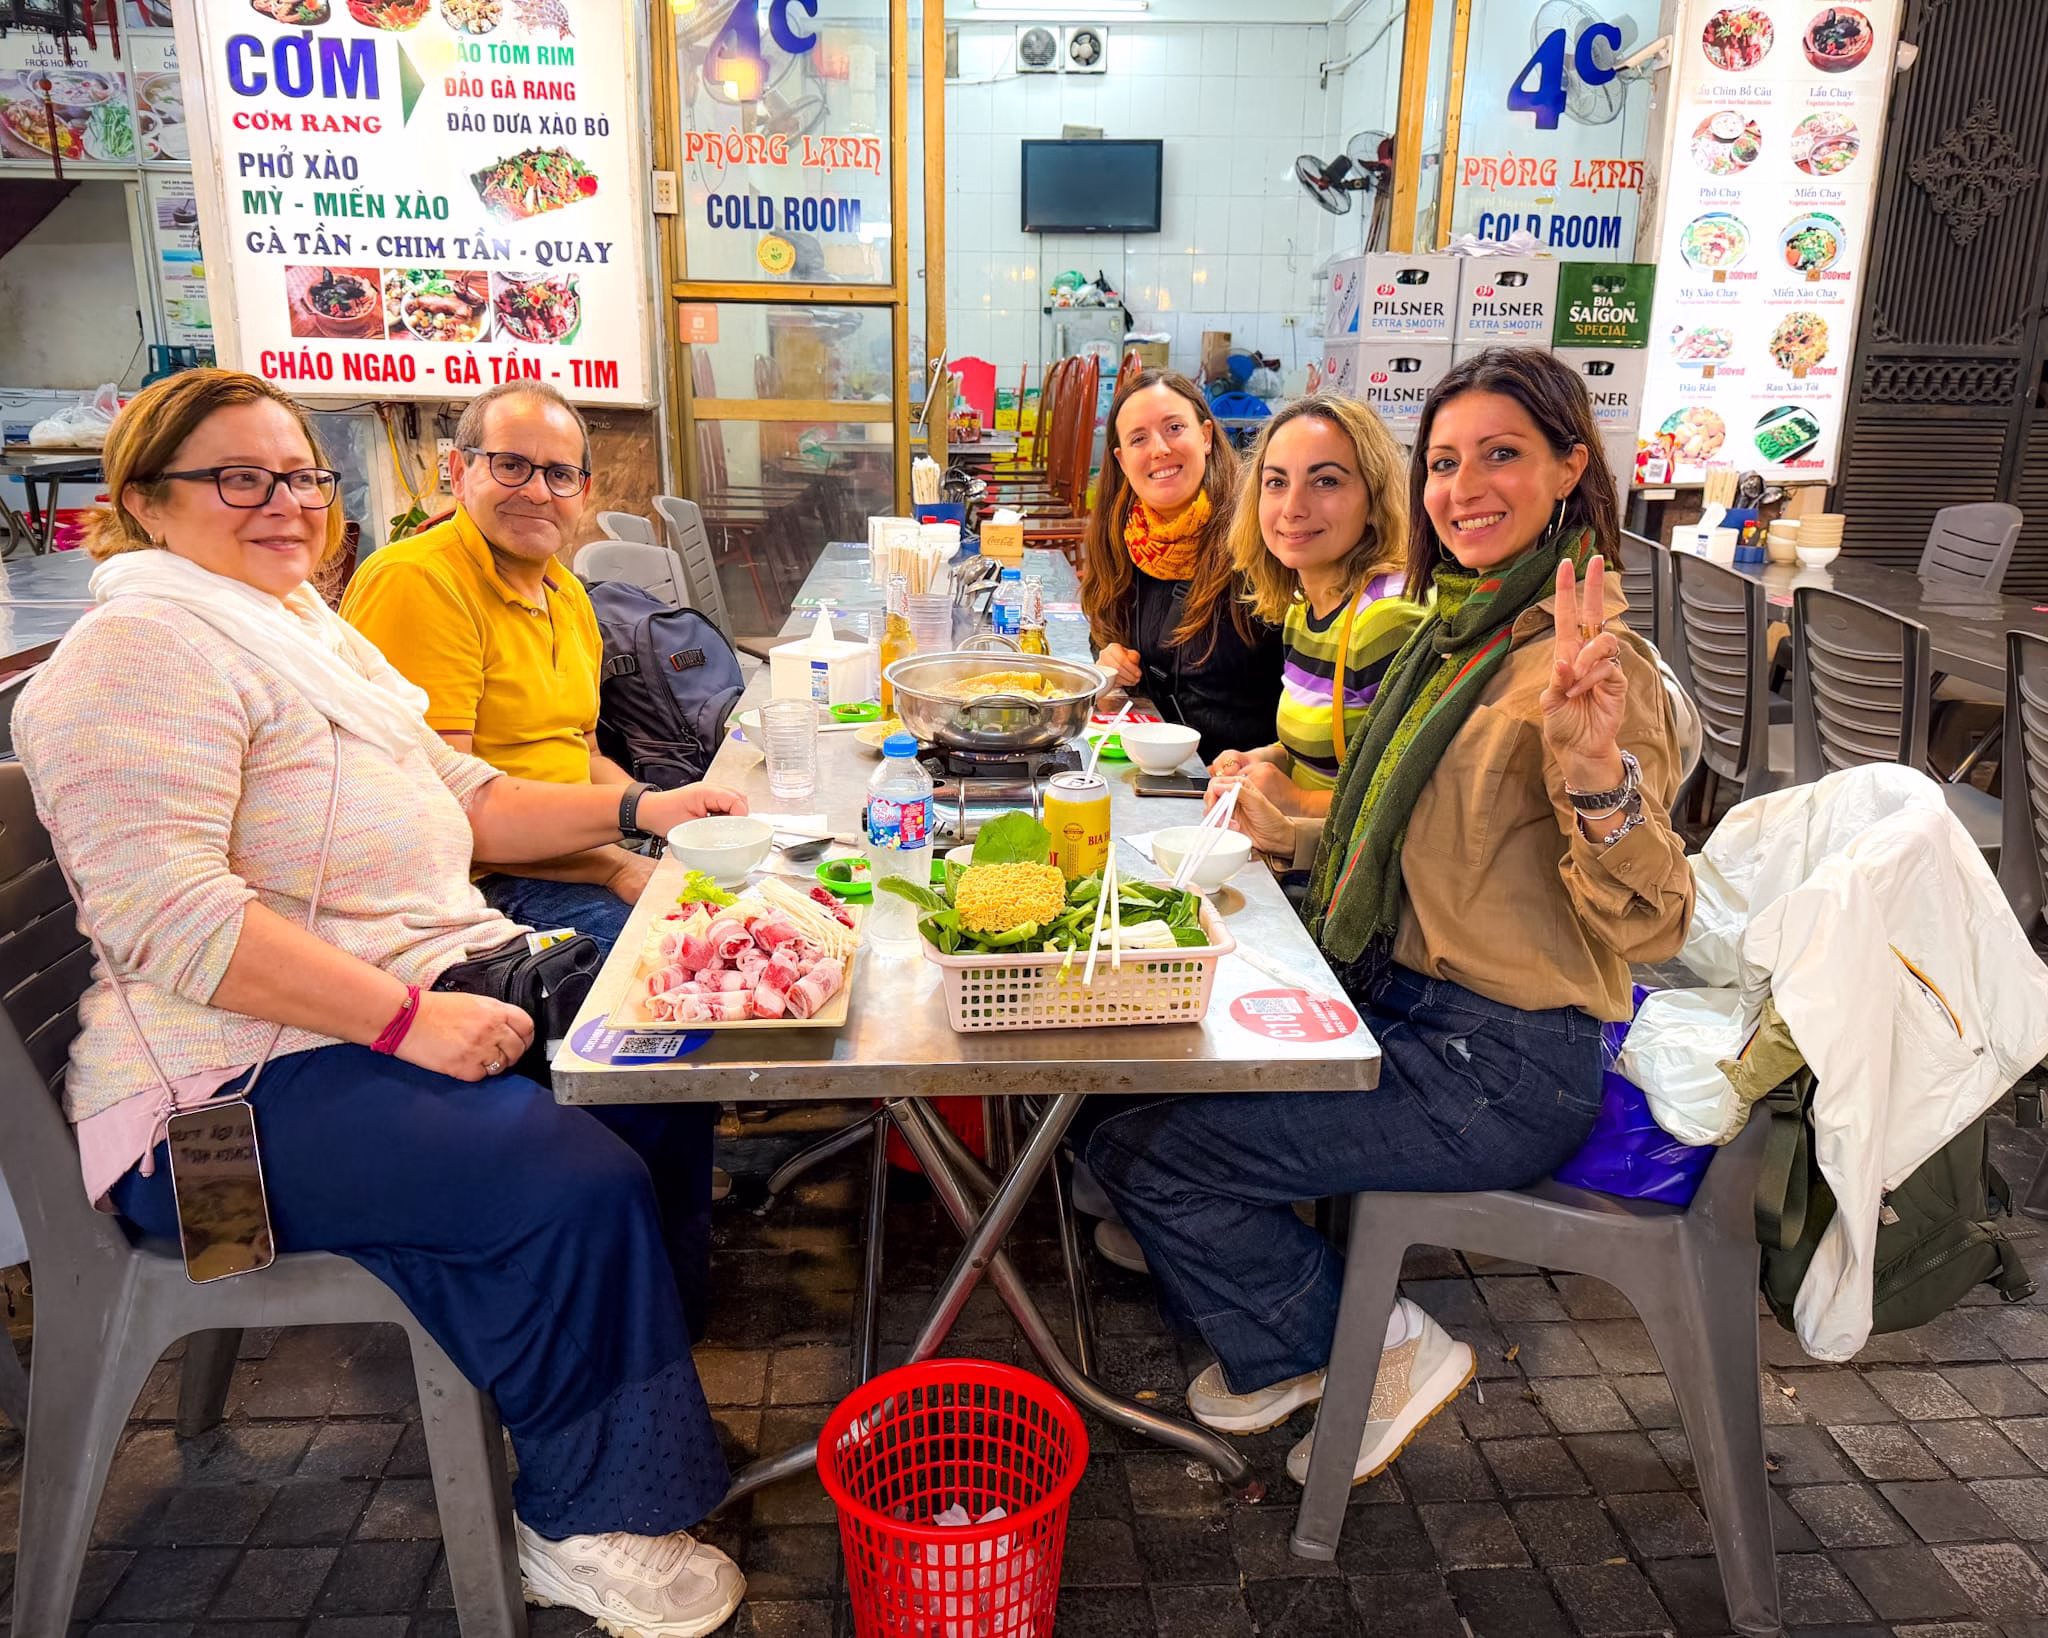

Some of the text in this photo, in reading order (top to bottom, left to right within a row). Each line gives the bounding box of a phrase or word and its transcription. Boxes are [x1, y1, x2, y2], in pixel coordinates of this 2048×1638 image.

[25, 58, 88, 68] FROG HOPOT
[225, 29, 381, 100] CƠM
[457, 36, 575, 66] ẢO TÔM RIM
[444, 71, 576, 101] ĐẢO GÀ RANG
[232, 109, 382, 134] CƠM RANG
[446, 106, 610, 137] ĐẢO DƯA XÀO BÒ
[238, 144, 359, 181] PHỞ XÀO
[242, 185, 283, 216] MỲ
[313, 184, 386, 219] MIẾN
[395, 189, 450, 220] XÀO
[707, 193, 862, 233] COLD ROOM
[246, 225, 287, 255] GÀ
[293, 222, 352, 256] TẦN
[376, 235, 446, 259] CHIM
[453, 226, 511, 261] TẦN
[535, 240, 613, 267] QUAY
[1548, 214, 1623, 249] ROOM
[1373, 301, 1445, 316] PILSNER
[1471, 302, 1545, 317] PILSNER
[1593, 296, 1614, 307] BIA
[1371, 318, 1445, 328] EXTRA SMOOTH
[1469, 319, 1543, 330] EXTRA SMOOTH
[1575, 324, 1629, 337] SPECIAL
[261, 345, 334, 381] CHÁO
[342, 353, 417, 383] NGAO
[445, 349, 482, 385] GÀ
[569, 358, 620, 390] TIM
[1594, 408, 1629, 418] MOOTH
[1088, 834, 1104, 846] BIA
